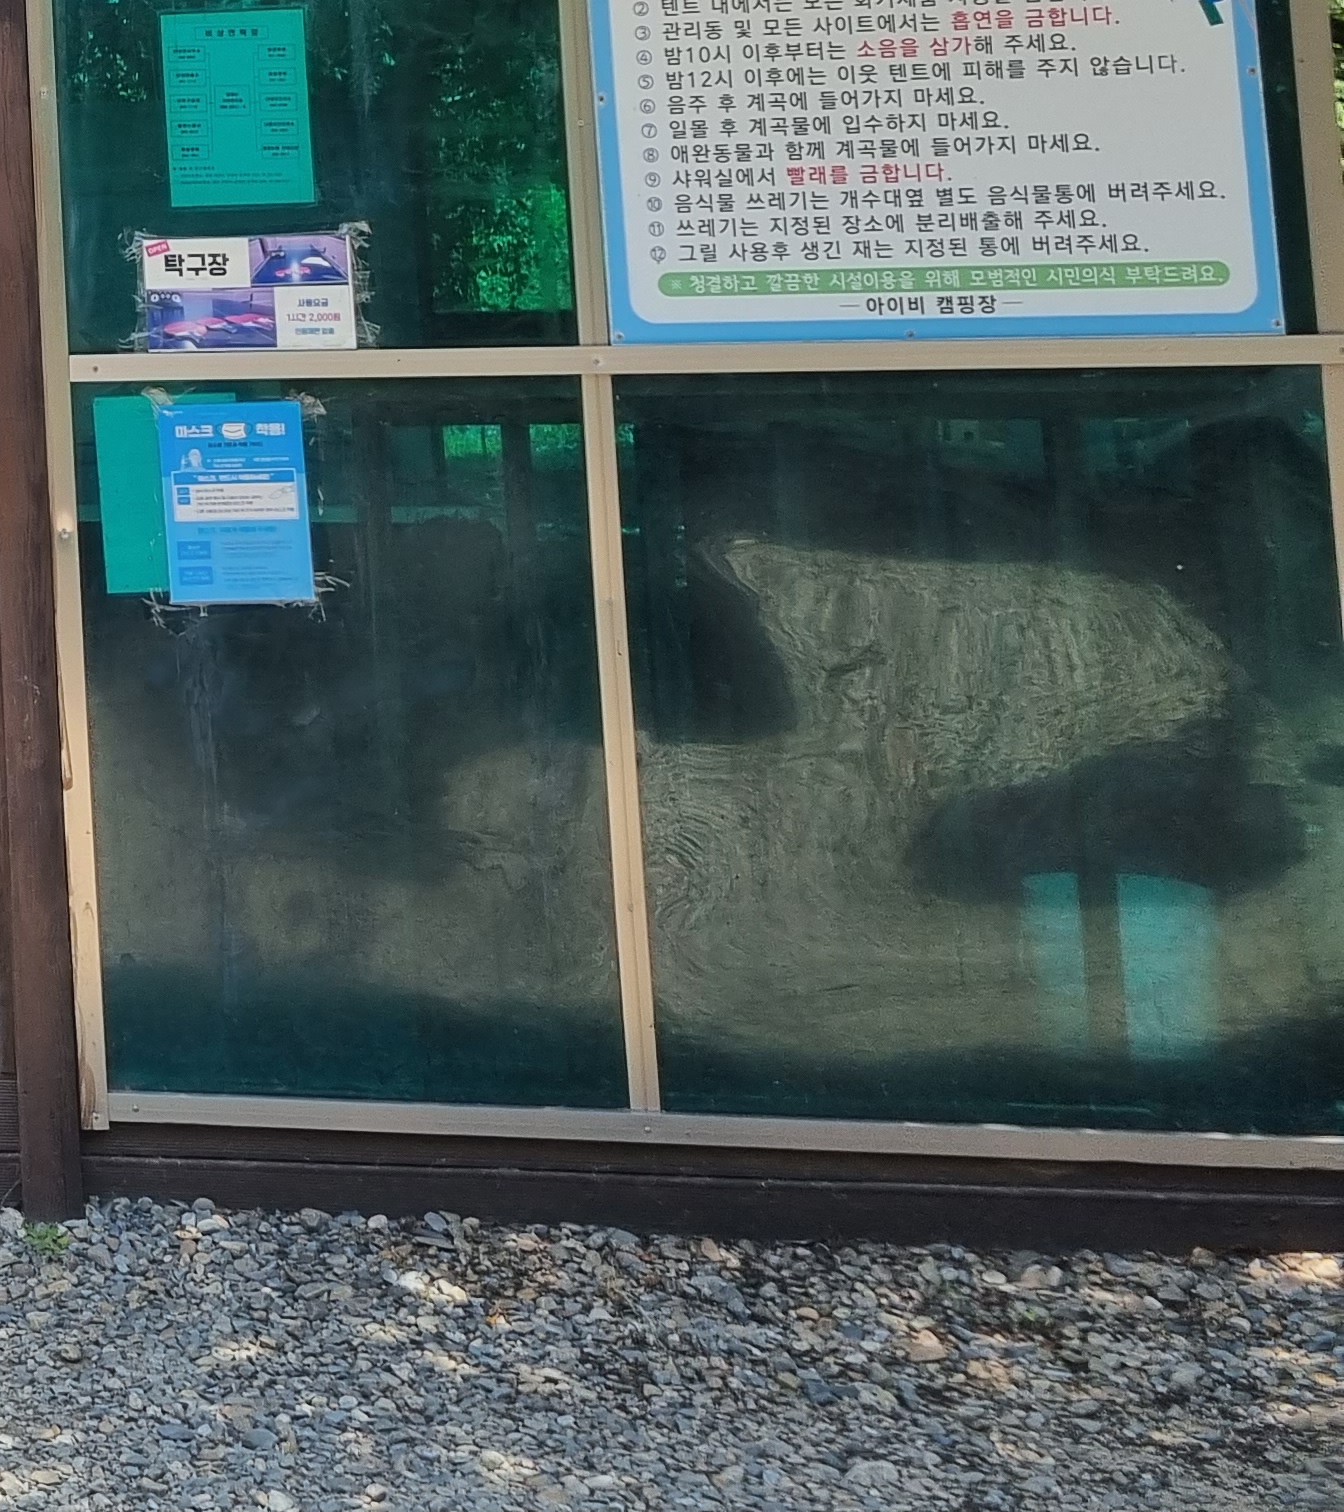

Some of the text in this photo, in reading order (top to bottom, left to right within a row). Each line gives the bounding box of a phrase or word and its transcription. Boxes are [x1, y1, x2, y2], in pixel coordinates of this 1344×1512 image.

[661, 20, 723, 41] 관리동
[734, 19, 752, 39] 및
[763, 17, 804, 37] 모든
[813, 13, 940, 35] 사이트에서는
[951, 8, 1014, 31] 흡연을
[1025, 5, 1120, 28] 금합니다.
[664, 45, 731, 66] 밤10시
[742, 40, 846, 63] 이후부터는
[856, 37, 920, 59] 소음을
[929, 34, 993, 57] 삼가해
[1003, 32, 1076, 53] 주세요.
[665, 69, 734, 90] 밤12시
[744, 66, 827, 87] 이후에는
[837, 64, 878, 84] 이웃
[889, 60, 951, 83] 텐트에
[962, 58, 1026, 81] 피해를
[1036, 57, 1079, 78] 주지
[1089, 53, 1186, 76] 않습니다.
[667, 95, 708, 115] 음주
[717, 93, 737, 113] 후
[746, 91, 809, 111] 계곡에
[819, 88, 902, 109] 들어가지
[914, 85, 985, 108] 마세요.
[669, 119, 709, 140] 일몰
[719, 118, 739, 137] 후
[749, 115, 832, 136] 계곡물에
[842, 112, 926, 135] 입수하지
[938, 110, 1009, 132] 마세요.
[670, 142, 775, 164] 애완동물과
[785, 140, 826, 161] 함께
[836, 138, 920, 160] 계곡물에
[931, 135, 1016, 158] 들어가지
[1028, 132, 1100, 154] 마세요.
[672, 166, 776, 188] 샤워실에서
[787, 165, 849, 186] 빨래를
[859, 162, 952, 183] 금합니다.
[674, 193, 736, 213] 음식물
[746, 190, 830, 212] 쓰레기는
[840, 188, 924, 210] 개수대옆
[936, 186, 978, 208] 별도
[987, 182, 1096, 206] 음식물통에
[1108, 180, 1226, 203] 버려주세요.
[676, 216, 759, 238] 쓰레기는
[769, 215, 831, 236] 지정된
[841, 213, 905, 235] 장소에
[916, 210, 1024, 233] 분리배출해
[1034, 208, 1107, 230] 주세요.
[678, 241, 718, 263] 그릴
[728, 240, 791, 262] 사용후
[800, 239, 841, 261] 생긴
[852, 238, 894, 259] 재는
[904, 236, 968, 258] 지정된
[978, 236, 1020, 256] 통에
[1032, 232, 1149, 256] 버려주세요.
[164, 252, 230, 278] 탁구장
[866, 294, 997, 315] 아이비 캠핑장
